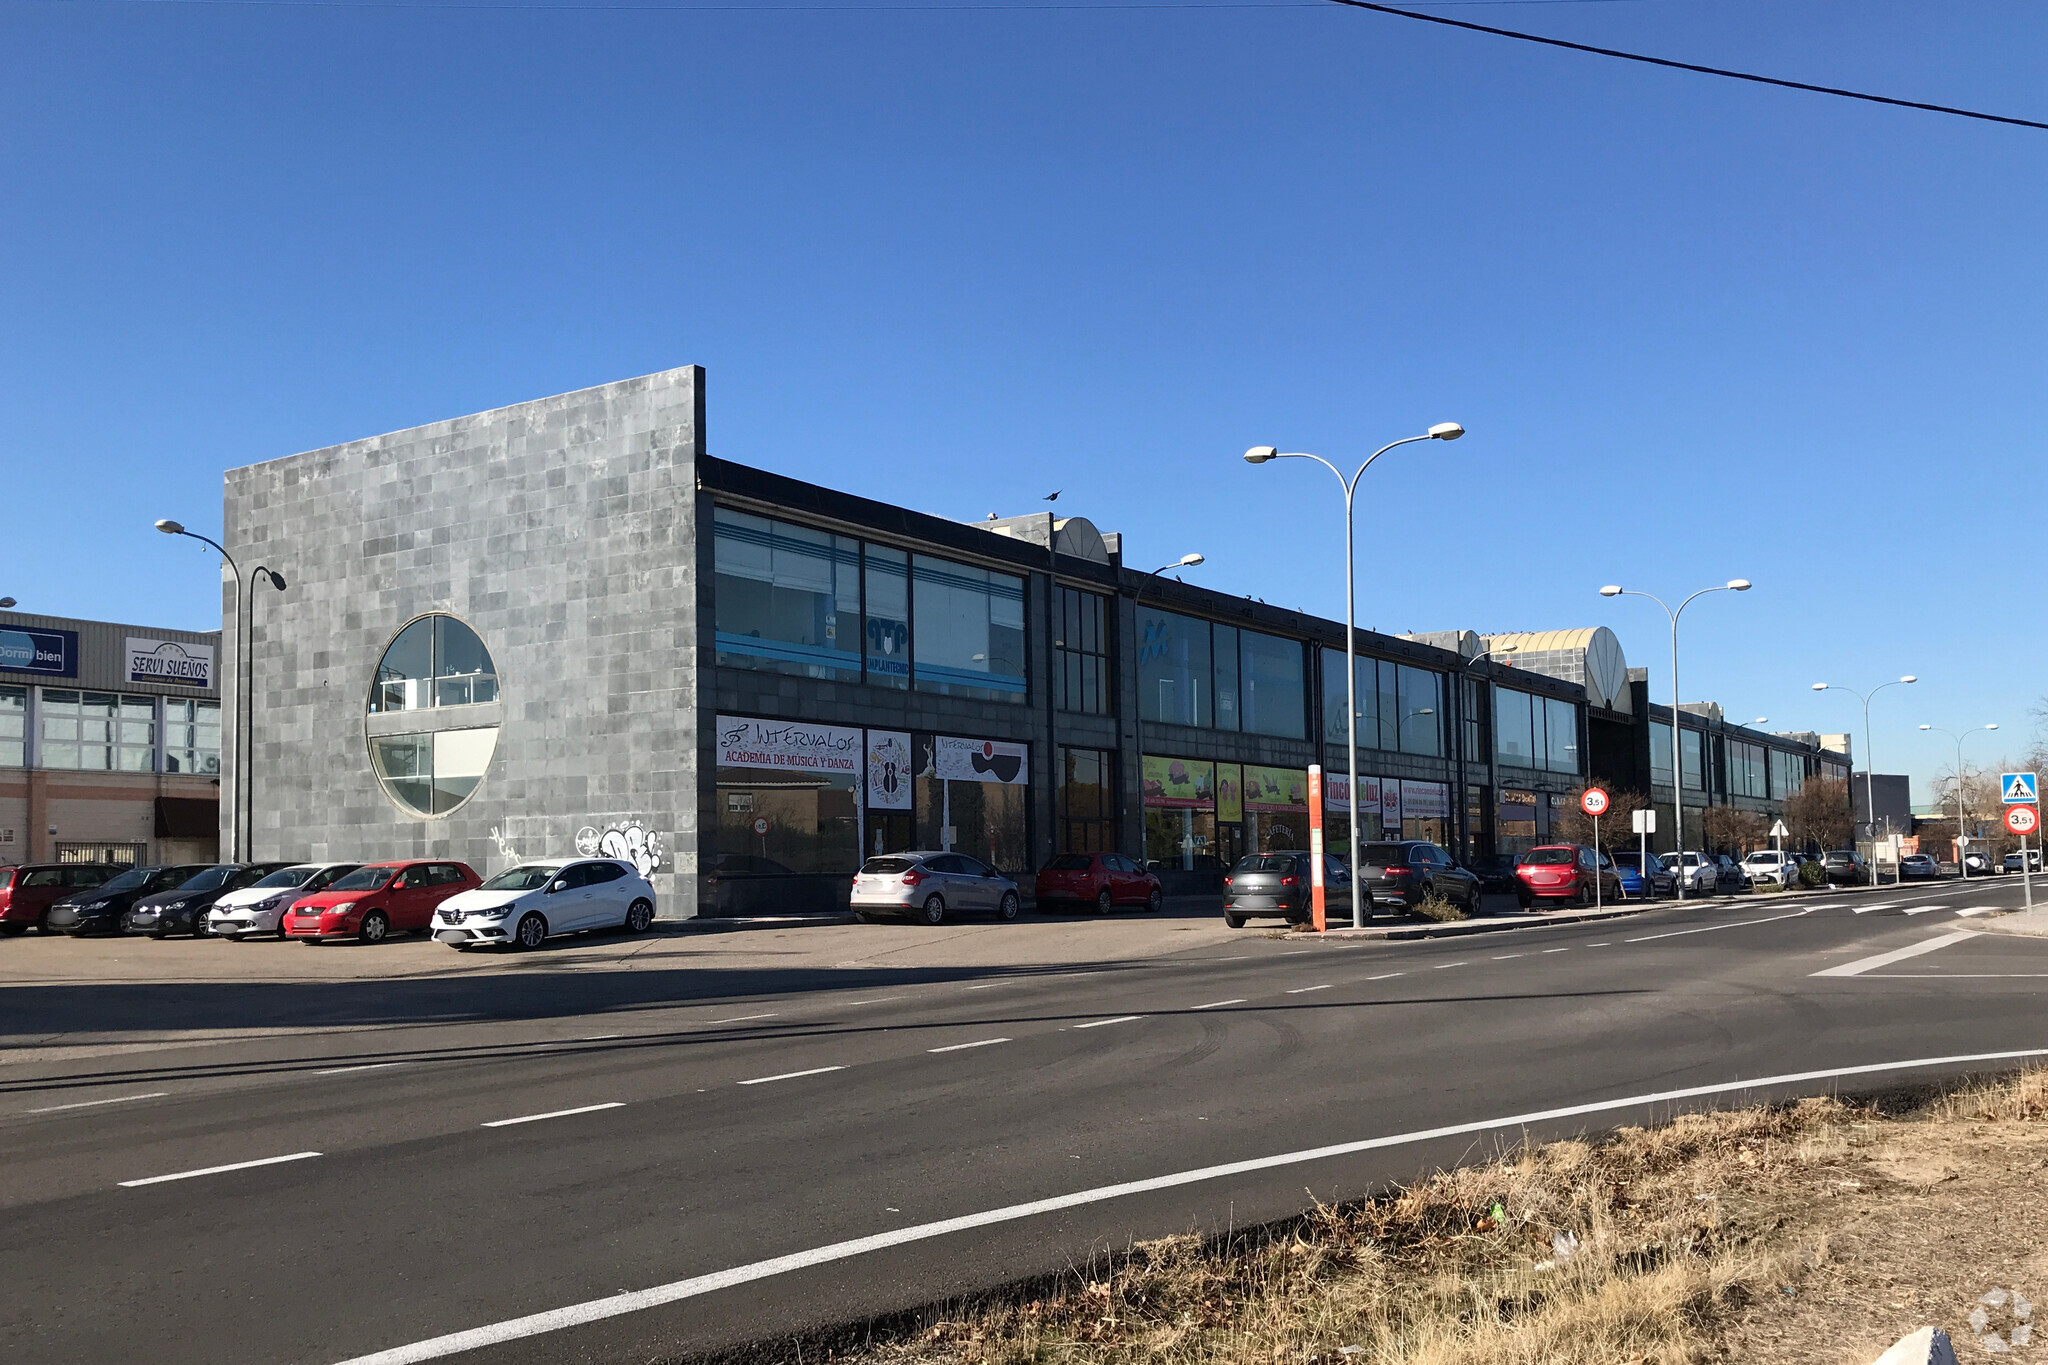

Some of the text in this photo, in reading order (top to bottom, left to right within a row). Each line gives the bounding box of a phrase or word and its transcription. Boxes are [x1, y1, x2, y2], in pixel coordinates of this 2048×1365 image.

[36, 649, 61, 662] bien
[132, 656, 208, 677] SERVI SUEÑOS
[756, 723, 854, 750] INTERVALOS
[725, 750, 855, 770] ACADEMIA DE MÚSICA Y DANZA
